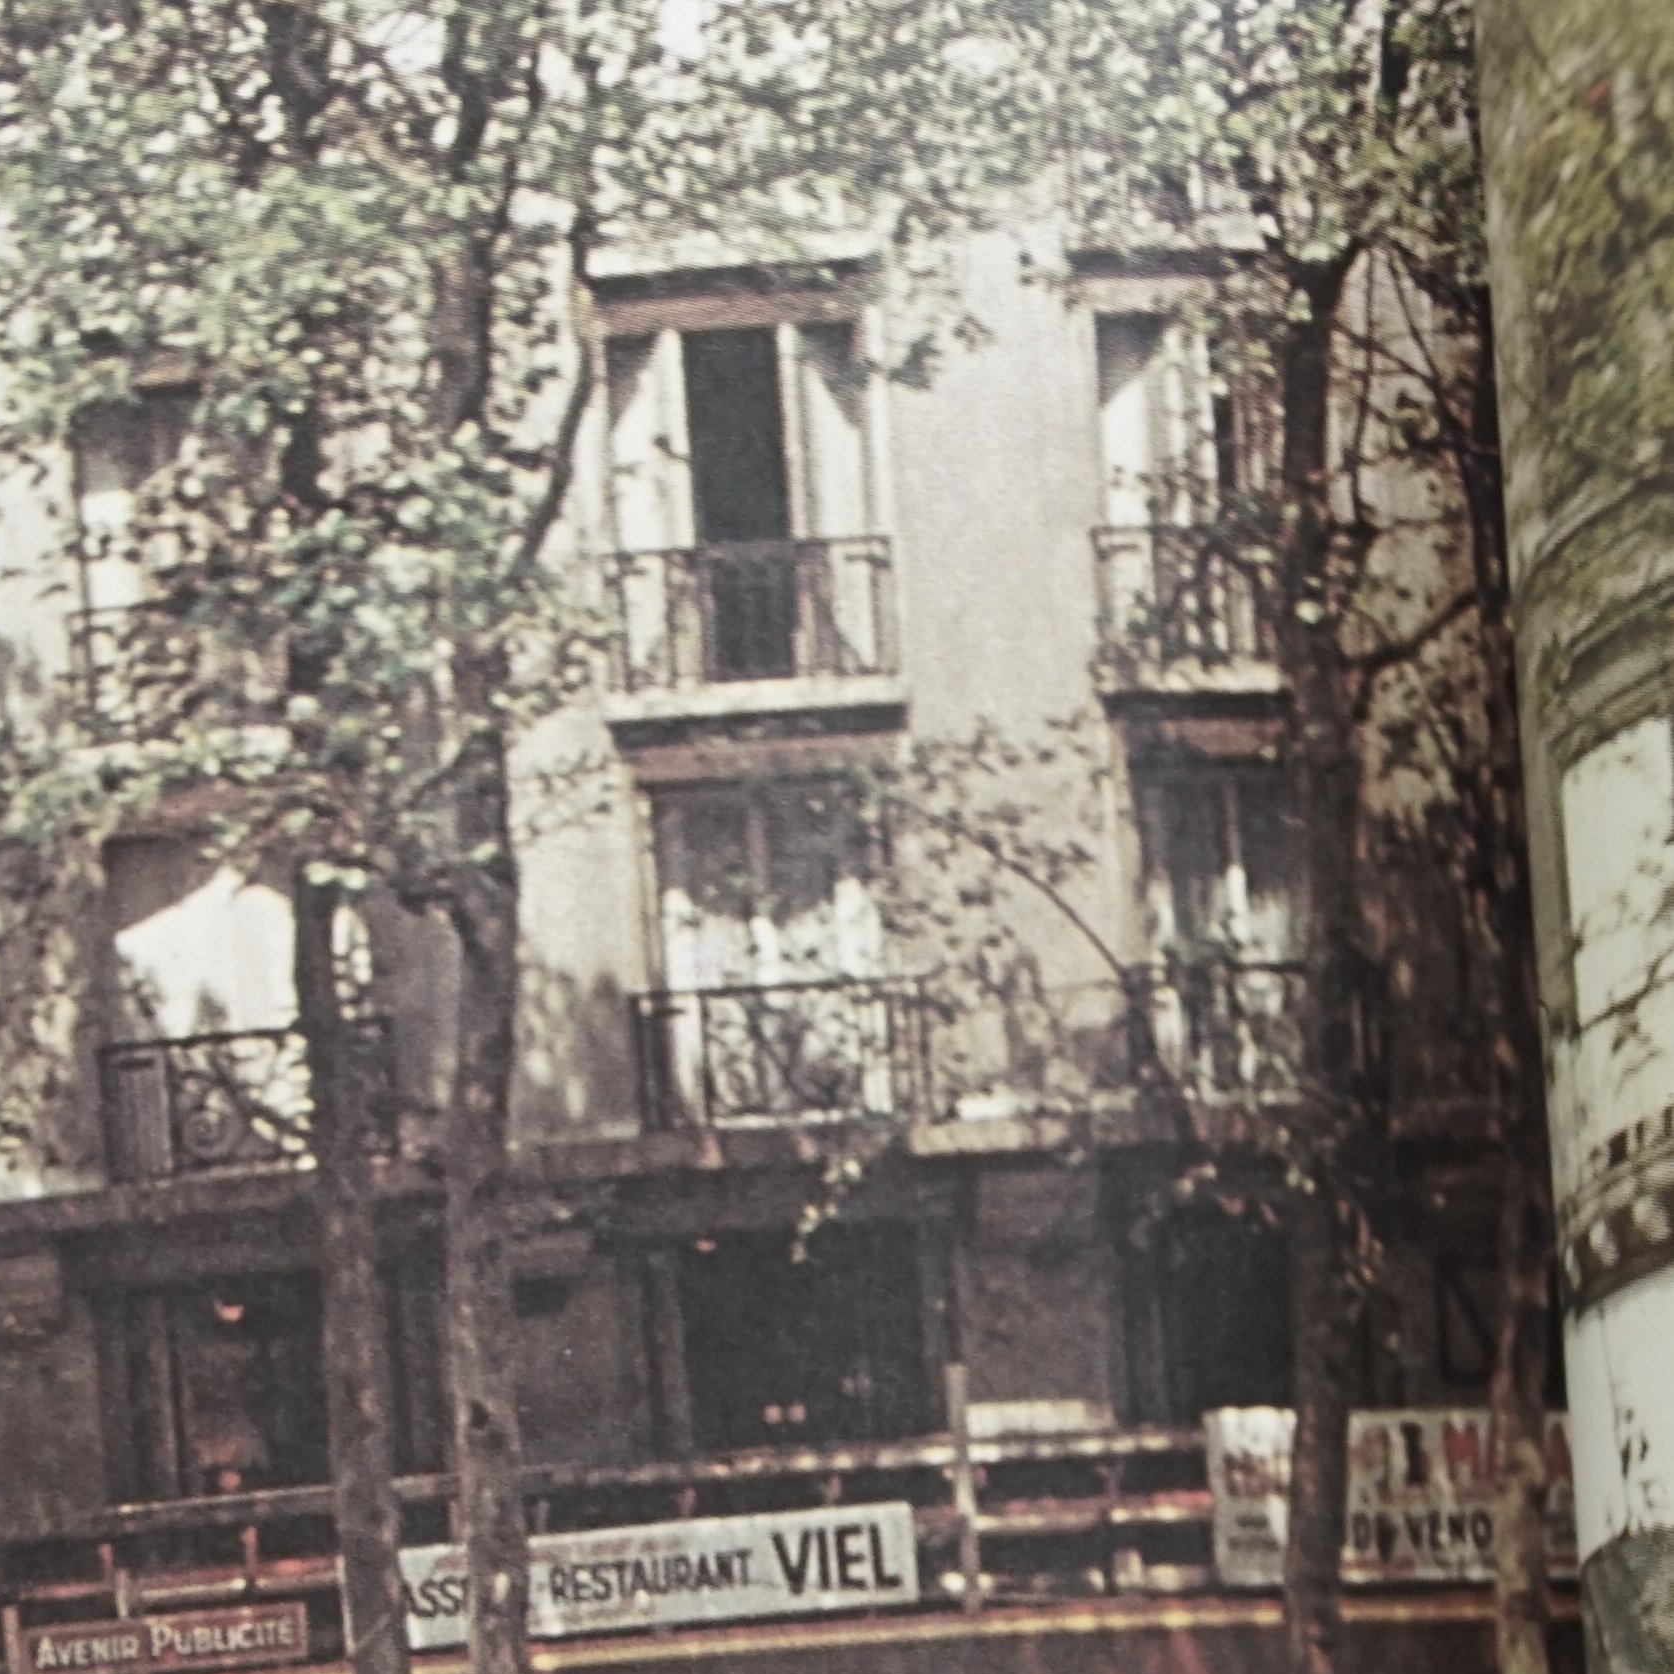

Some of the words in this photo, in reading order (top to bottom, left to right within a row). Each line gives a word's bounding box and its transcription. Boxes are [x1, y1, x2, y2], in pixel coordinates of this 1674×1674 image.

[549, 1549, 753, 1602] RESTAURANT
[771, 1522, 902, 1595] VIEL
[37, 1635, 139, 1669] AVENIR
